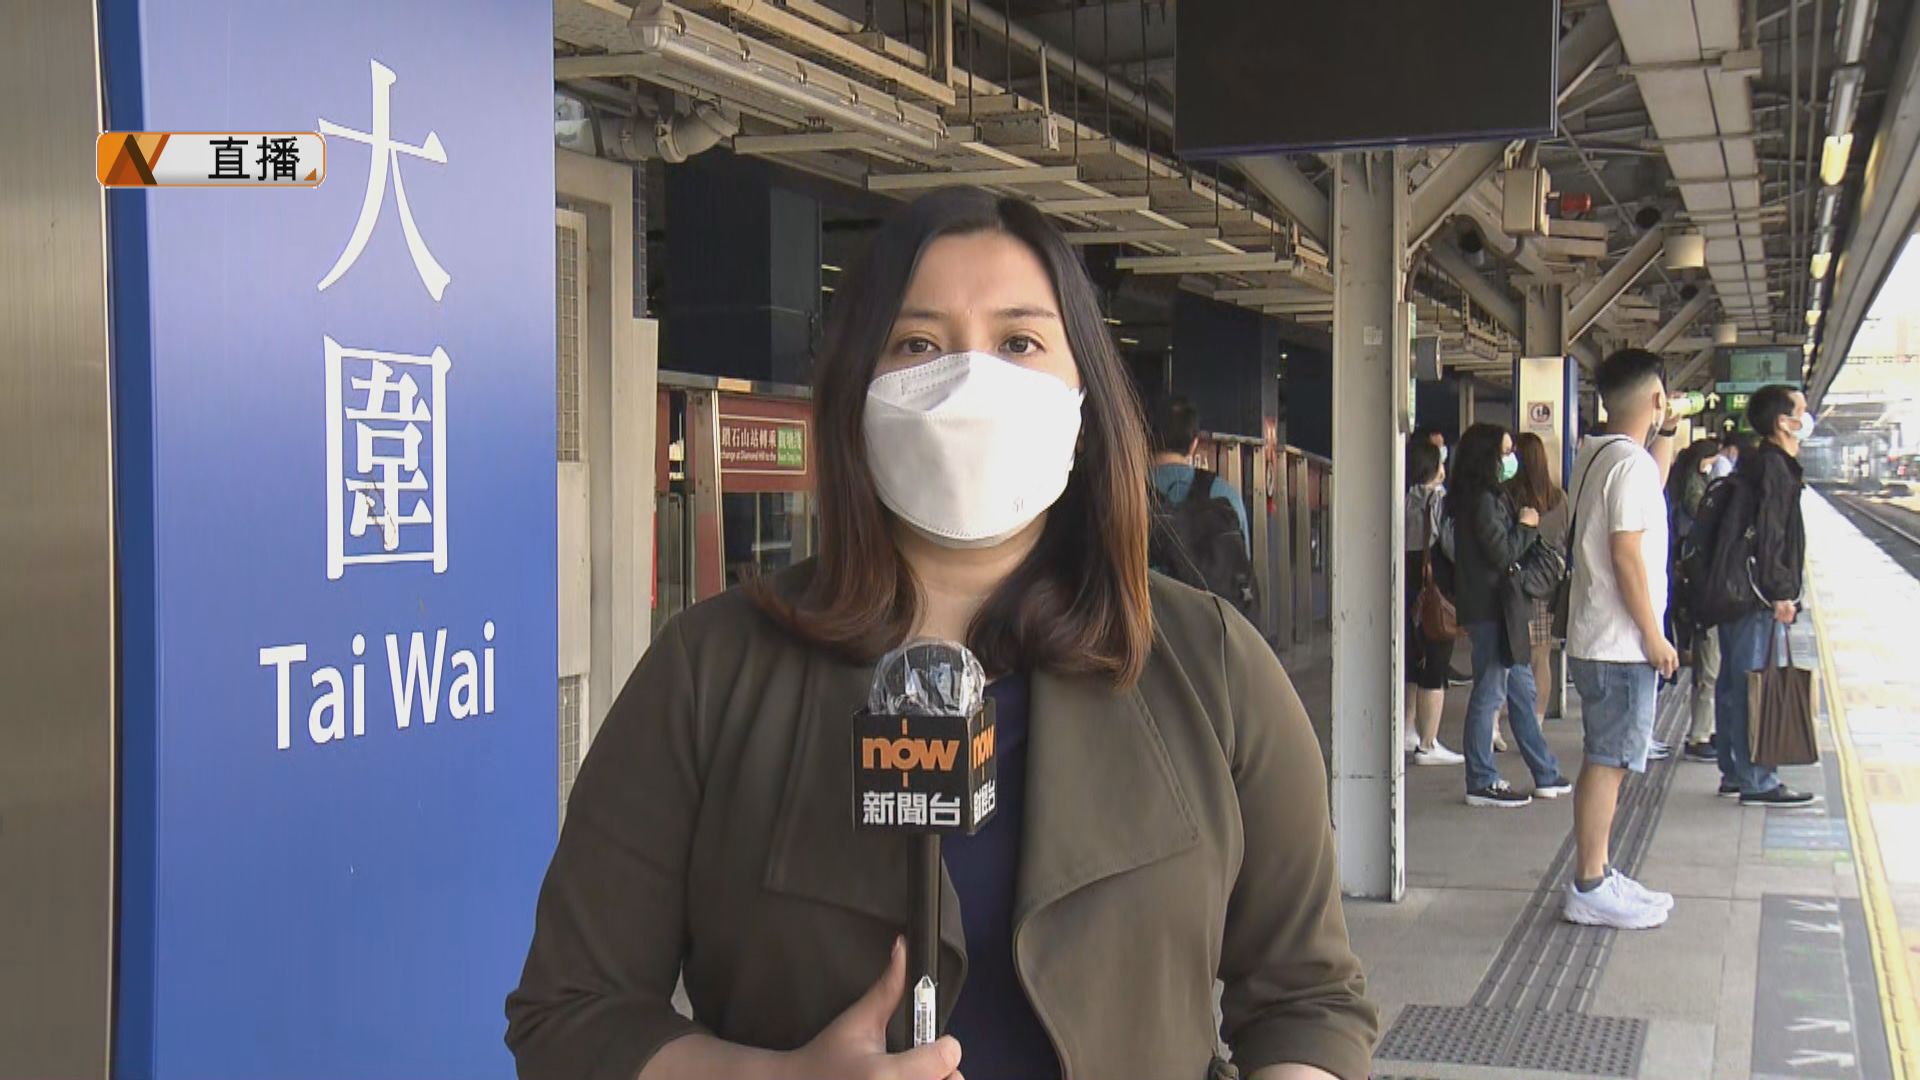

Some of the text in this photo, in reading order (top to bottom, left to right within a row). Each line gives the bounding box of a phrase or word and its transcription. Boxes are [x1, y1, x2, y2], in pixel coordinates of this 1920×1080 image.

[317, 58, 452, 580] 大圍
[259, 620, 496, 750] Tai Wai
[862, 737, 960, 771] now
[973, 724, 995, 770] now
[862, 790, 961, 826] 新聞台
